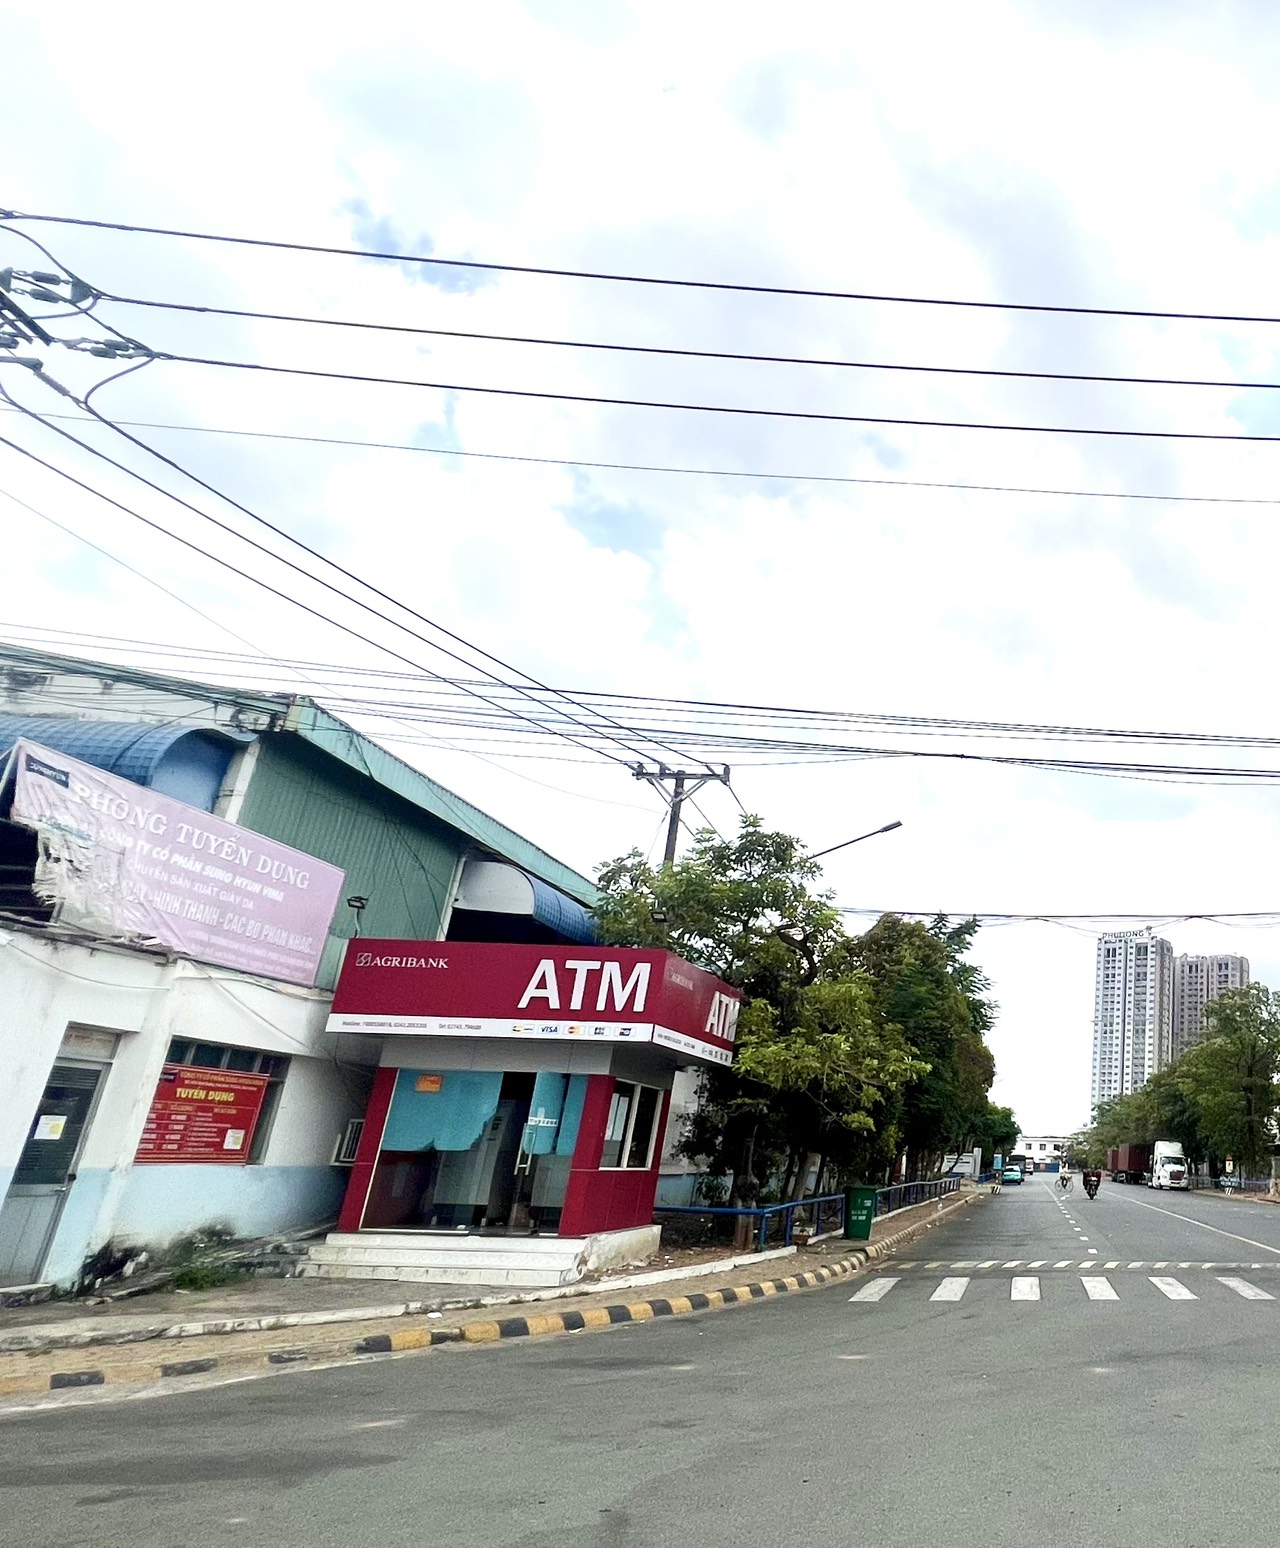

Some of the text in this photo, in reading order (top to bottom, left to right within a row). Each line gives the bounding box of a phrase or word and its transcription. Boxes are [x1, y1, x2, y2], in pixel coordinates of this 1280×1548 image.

[70, 782, 311, 890] PHÒNG TUYỂN DỤNG
[192, 882, 219, 898] XUẤT
[202, 865, 233, 883] SUNG
[233, 875, 262, 894] HYUN
[370, 955, 652, 1013] AGRIBANK ATM
[704, 990, 741, 1042] ATM
[207, 1089, 235, 1103] DỤNG
